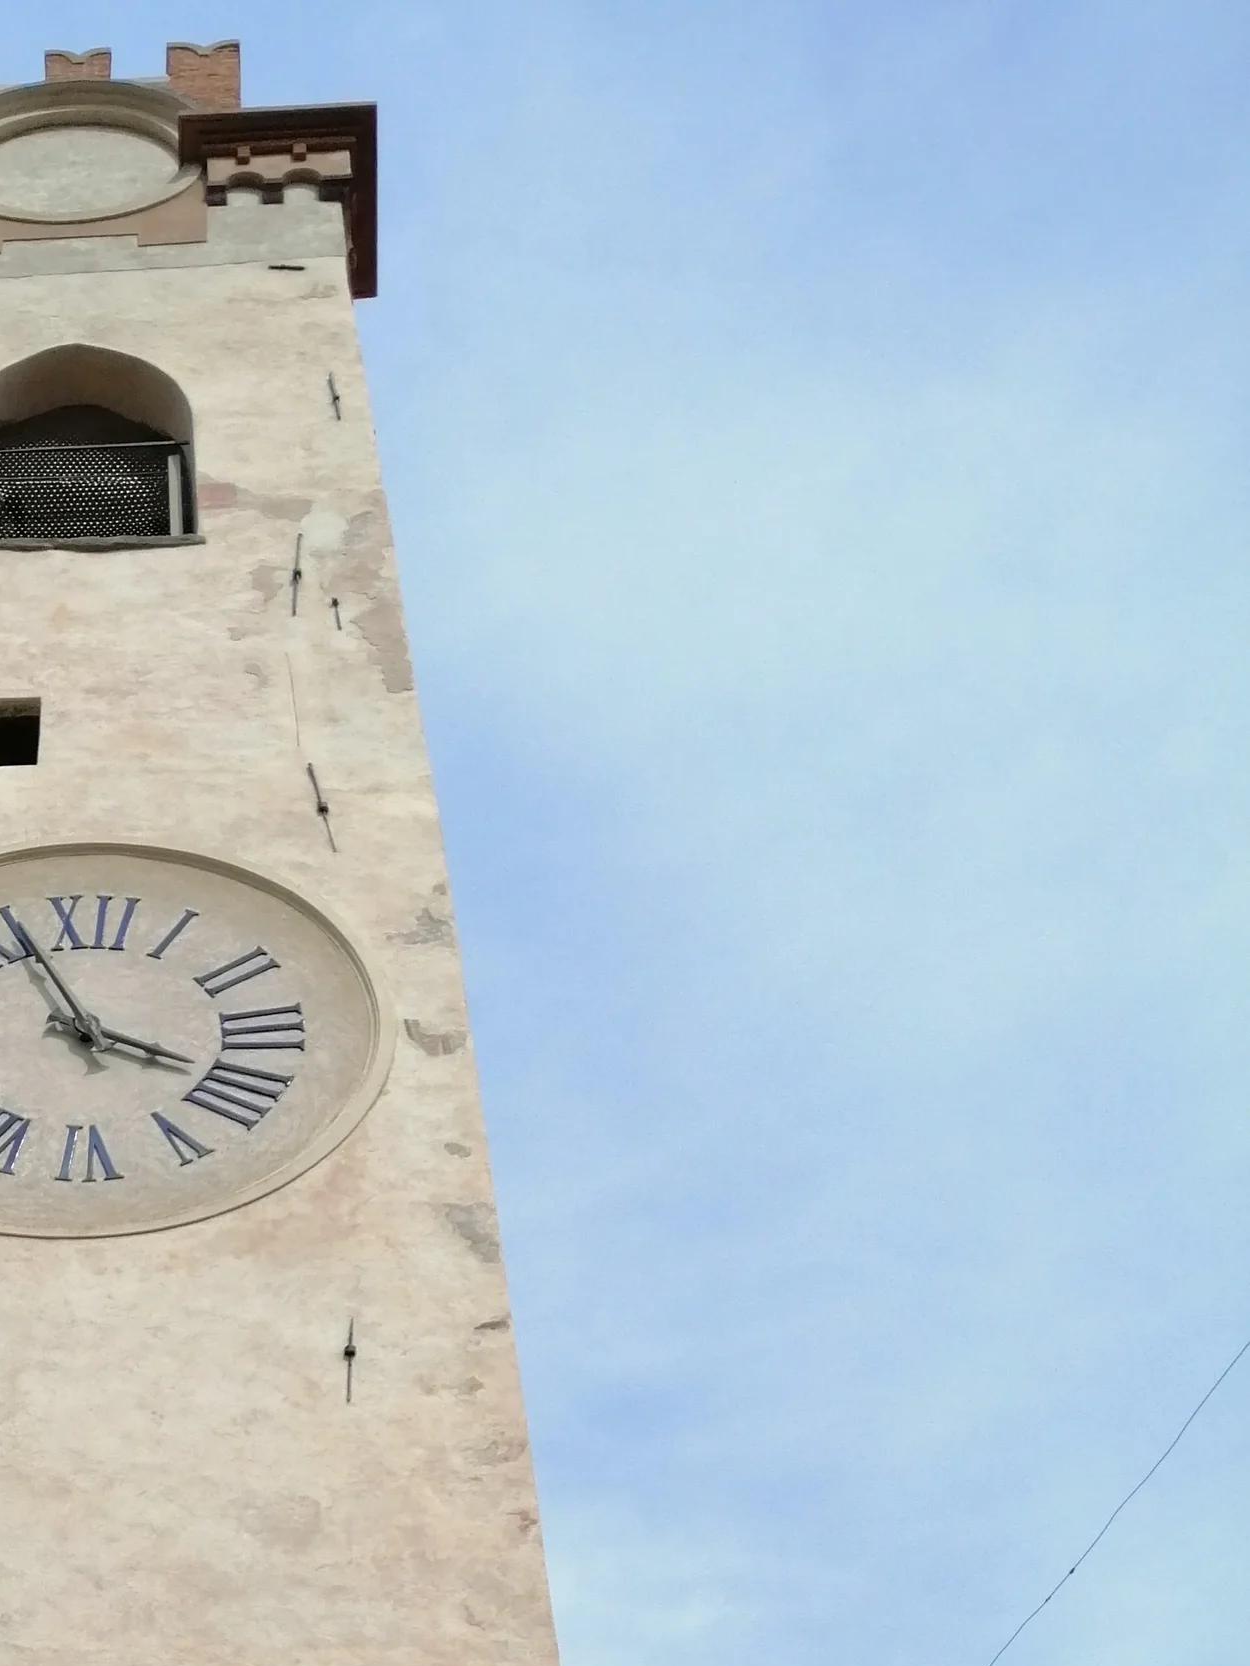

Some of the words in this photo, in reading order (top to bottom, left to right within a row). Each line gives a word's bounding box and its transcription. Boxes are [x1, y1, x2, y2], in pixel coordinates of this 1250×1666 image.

[47, 895, 142, 951] XII
[147, 909, 199, 959] I
[194, 946, 281, 997] II
[219, 1002, 306, 1051] III
[182, 1058, 295, 1131] IIII
[54, 1124, 125, 1182] VI
[151, 1111, 215, 1166] V
